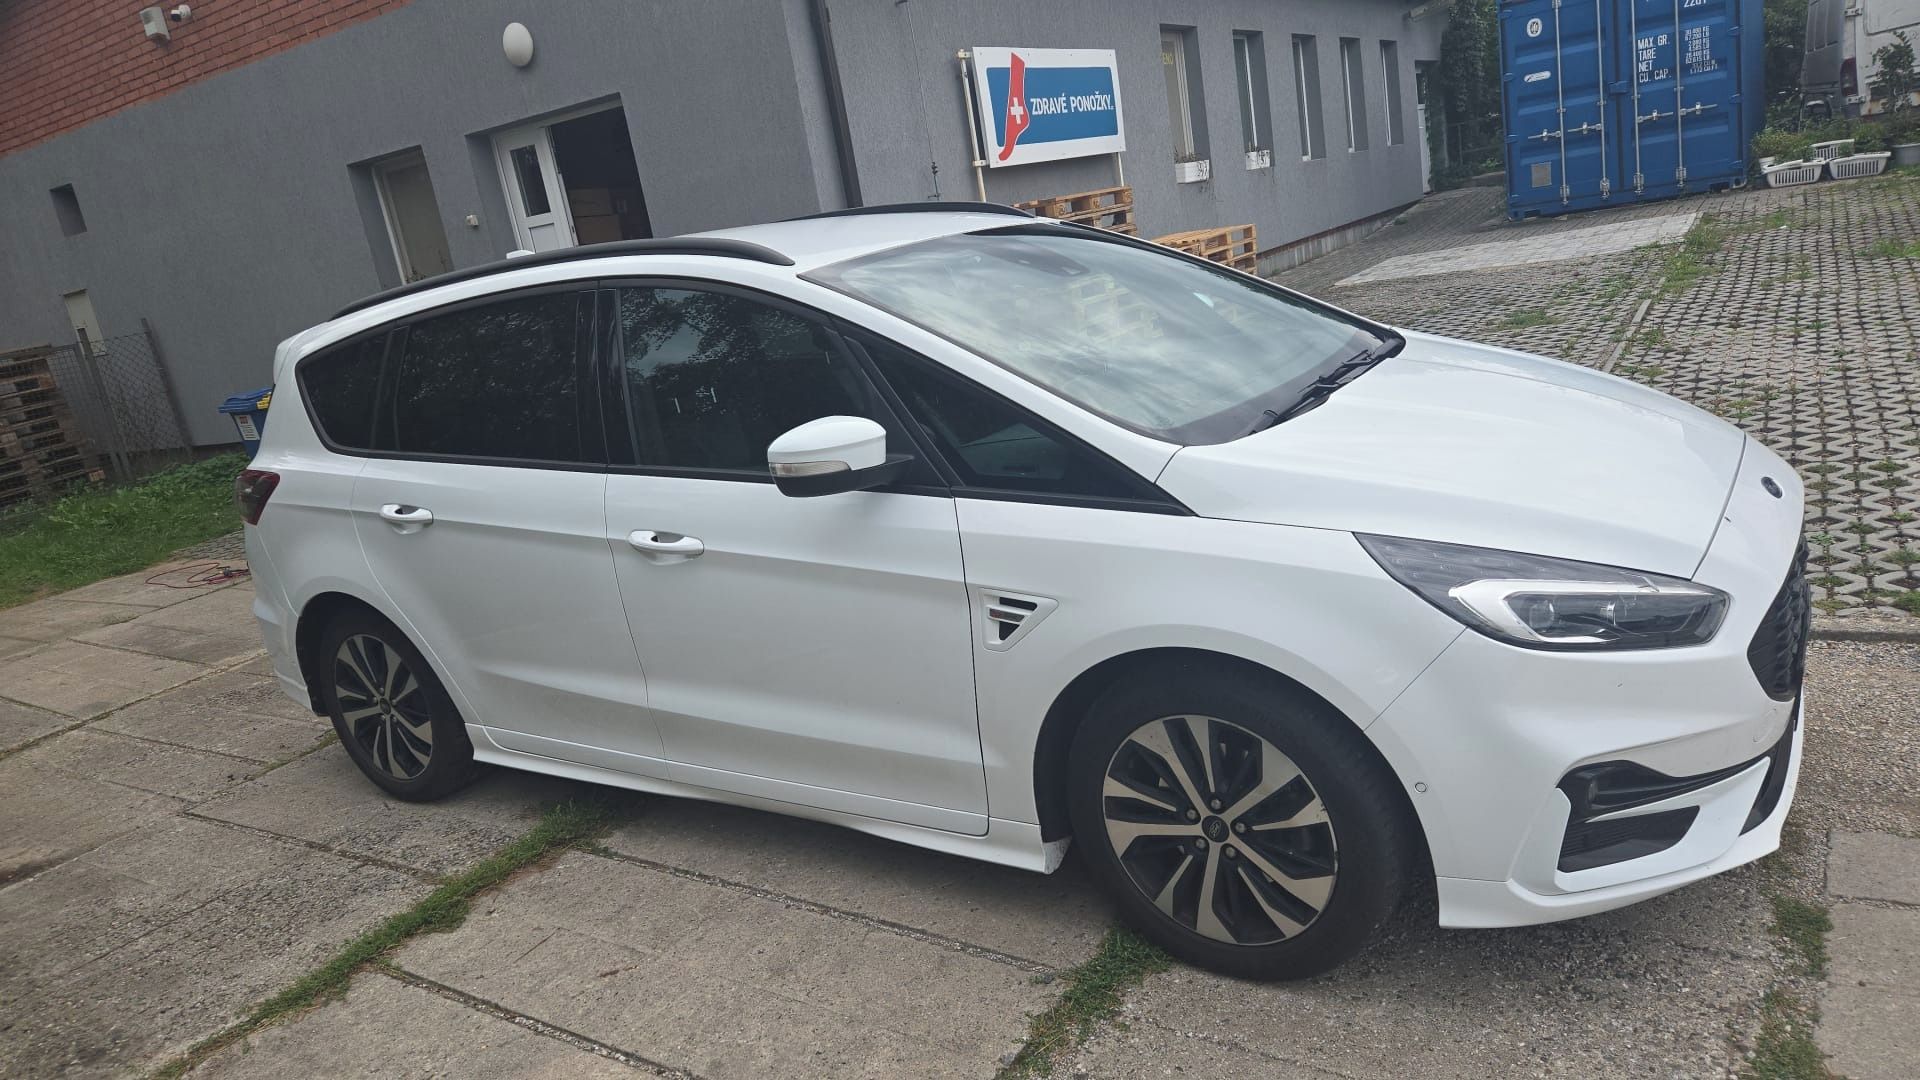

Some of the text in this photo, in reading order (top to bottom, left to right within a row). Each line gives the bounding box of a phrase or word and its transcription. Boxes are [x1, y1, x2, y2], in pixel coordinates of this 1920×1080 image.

[1638, 47, 1657, 62] TARE
[1638, 60, 1653, 73] NET
[1030, 92, 1068, 115] ZDRAVÉ
